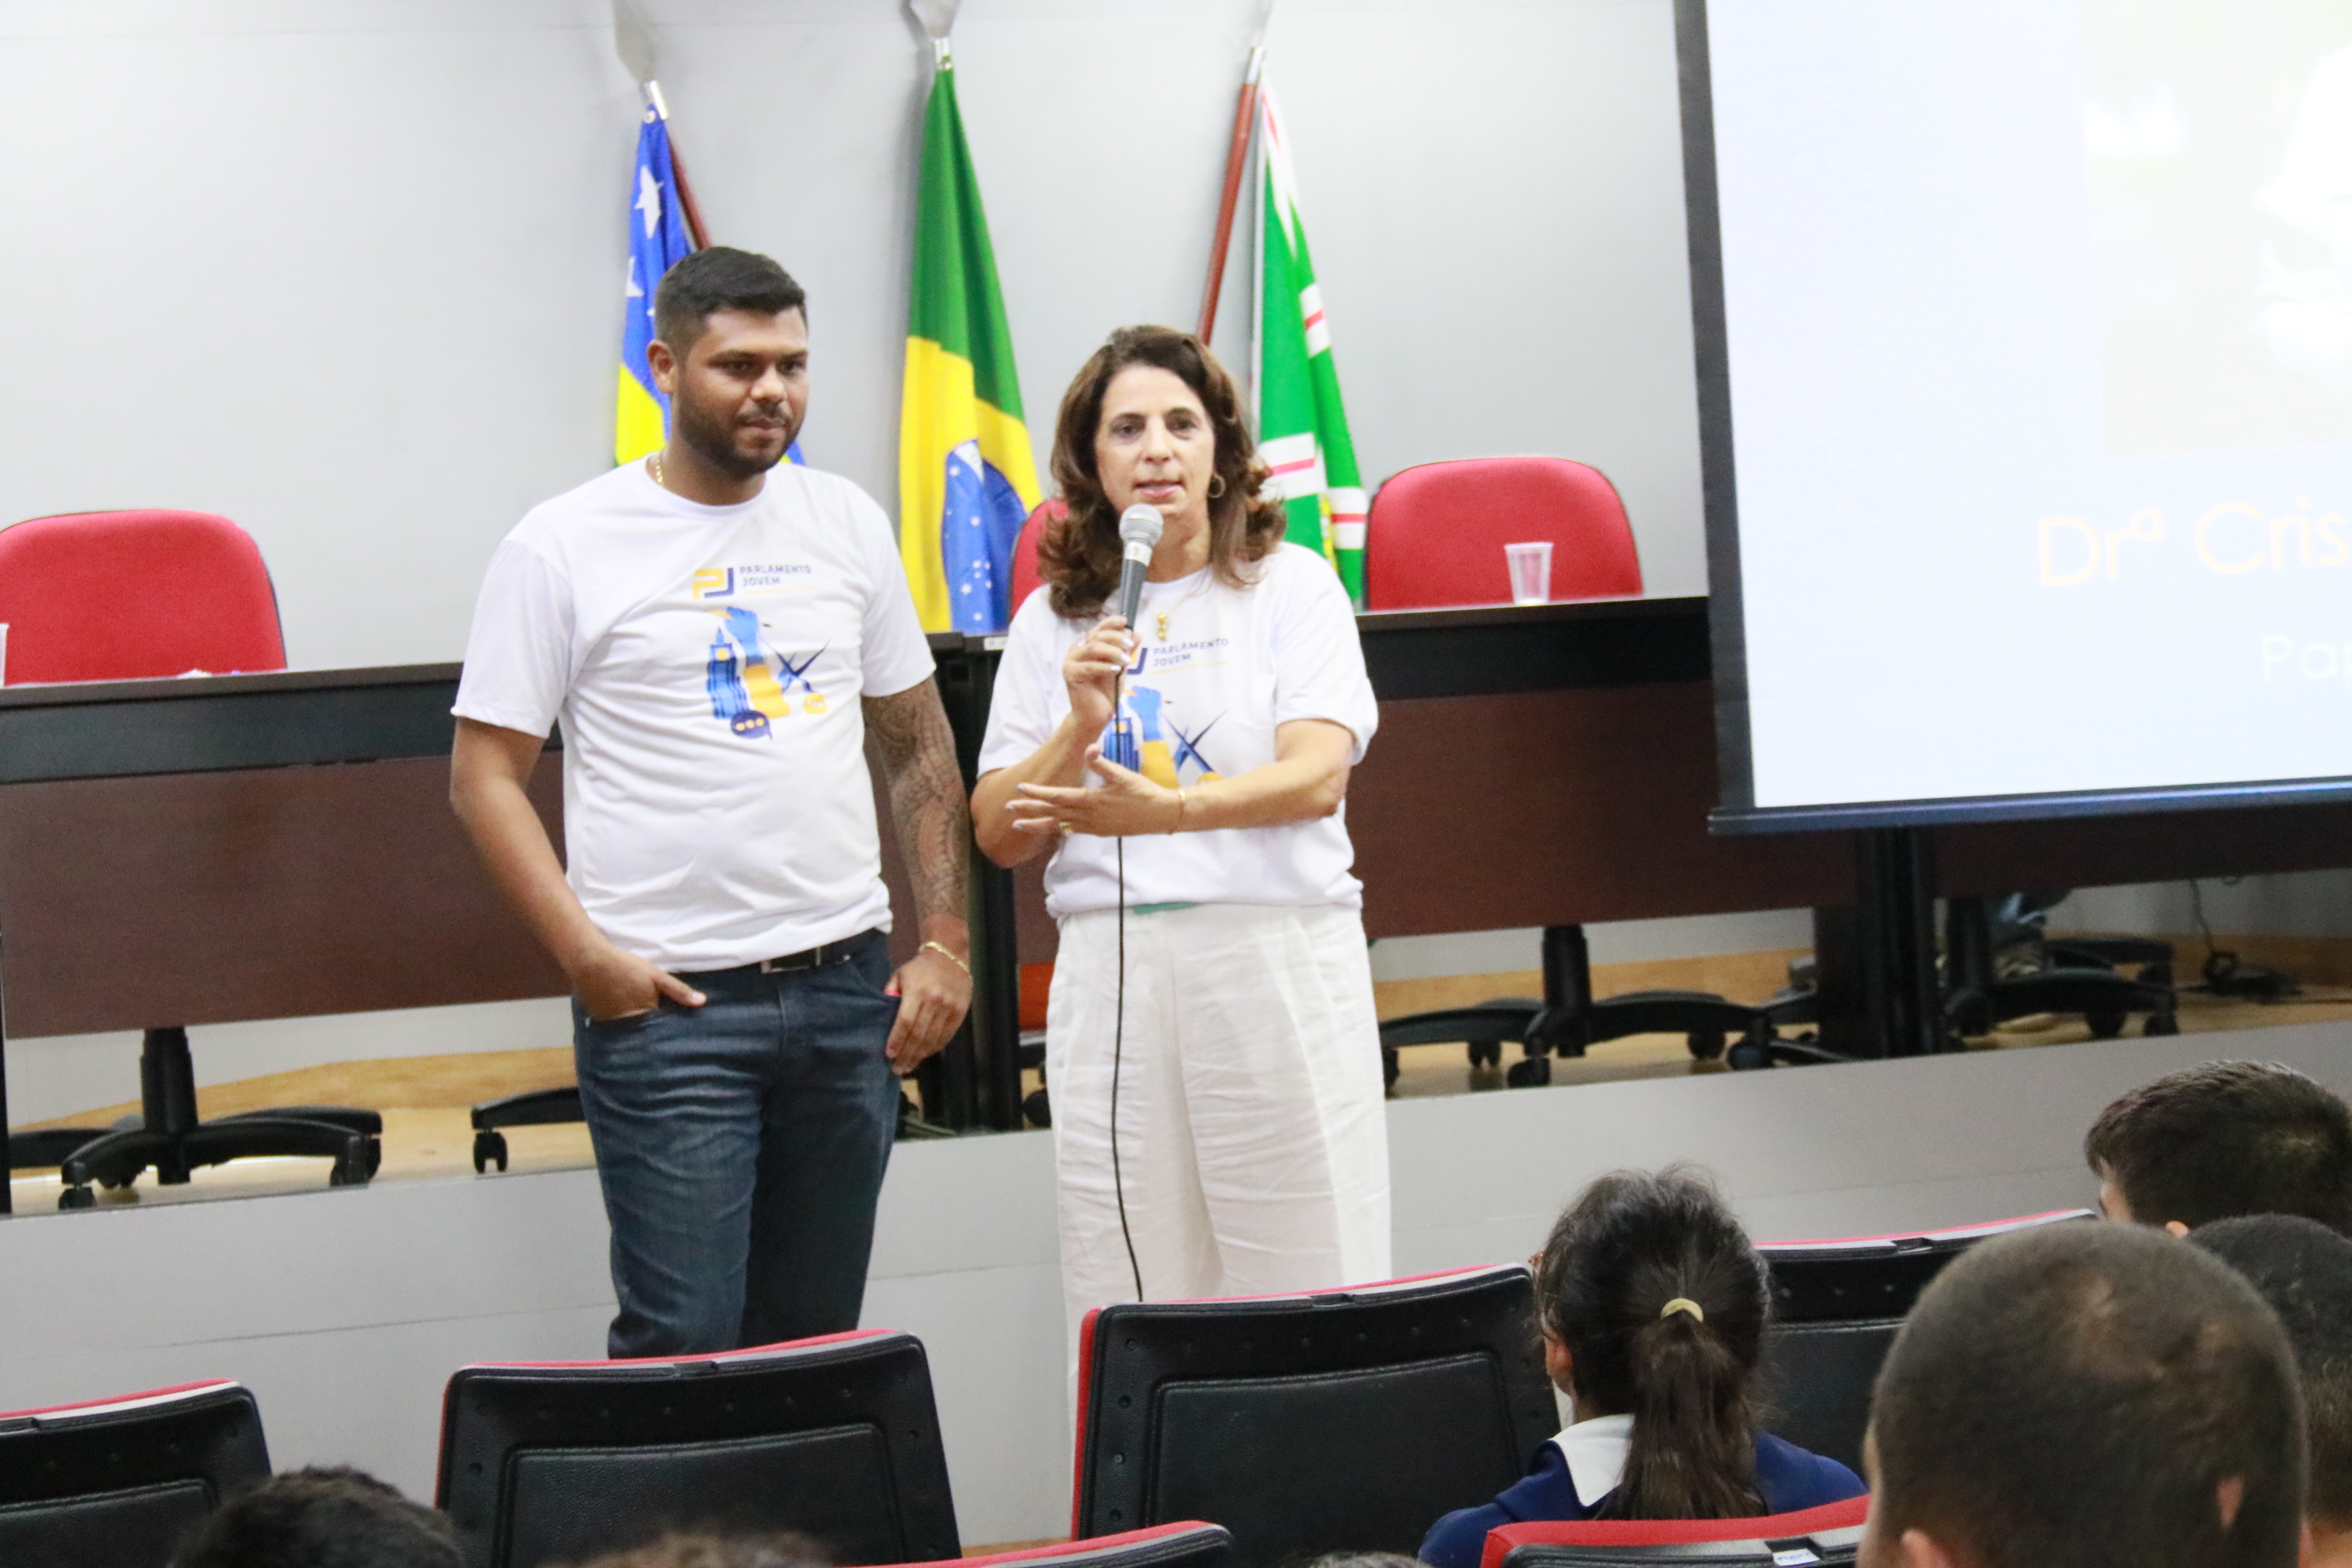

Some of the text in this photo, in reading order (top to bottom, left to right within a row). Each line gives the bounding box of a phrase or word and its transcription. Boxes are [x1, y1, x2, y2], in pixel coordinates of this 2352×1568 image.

[2194, 495, 2350, 575] Cris
[740, 564, 812, 575] PARLAMENTO
[743, 576, 781, 587] JOVEM
[1153, 639, 1229, 655] PARLAMENTO
[1153, 654, 1191, 667] JOVEM
